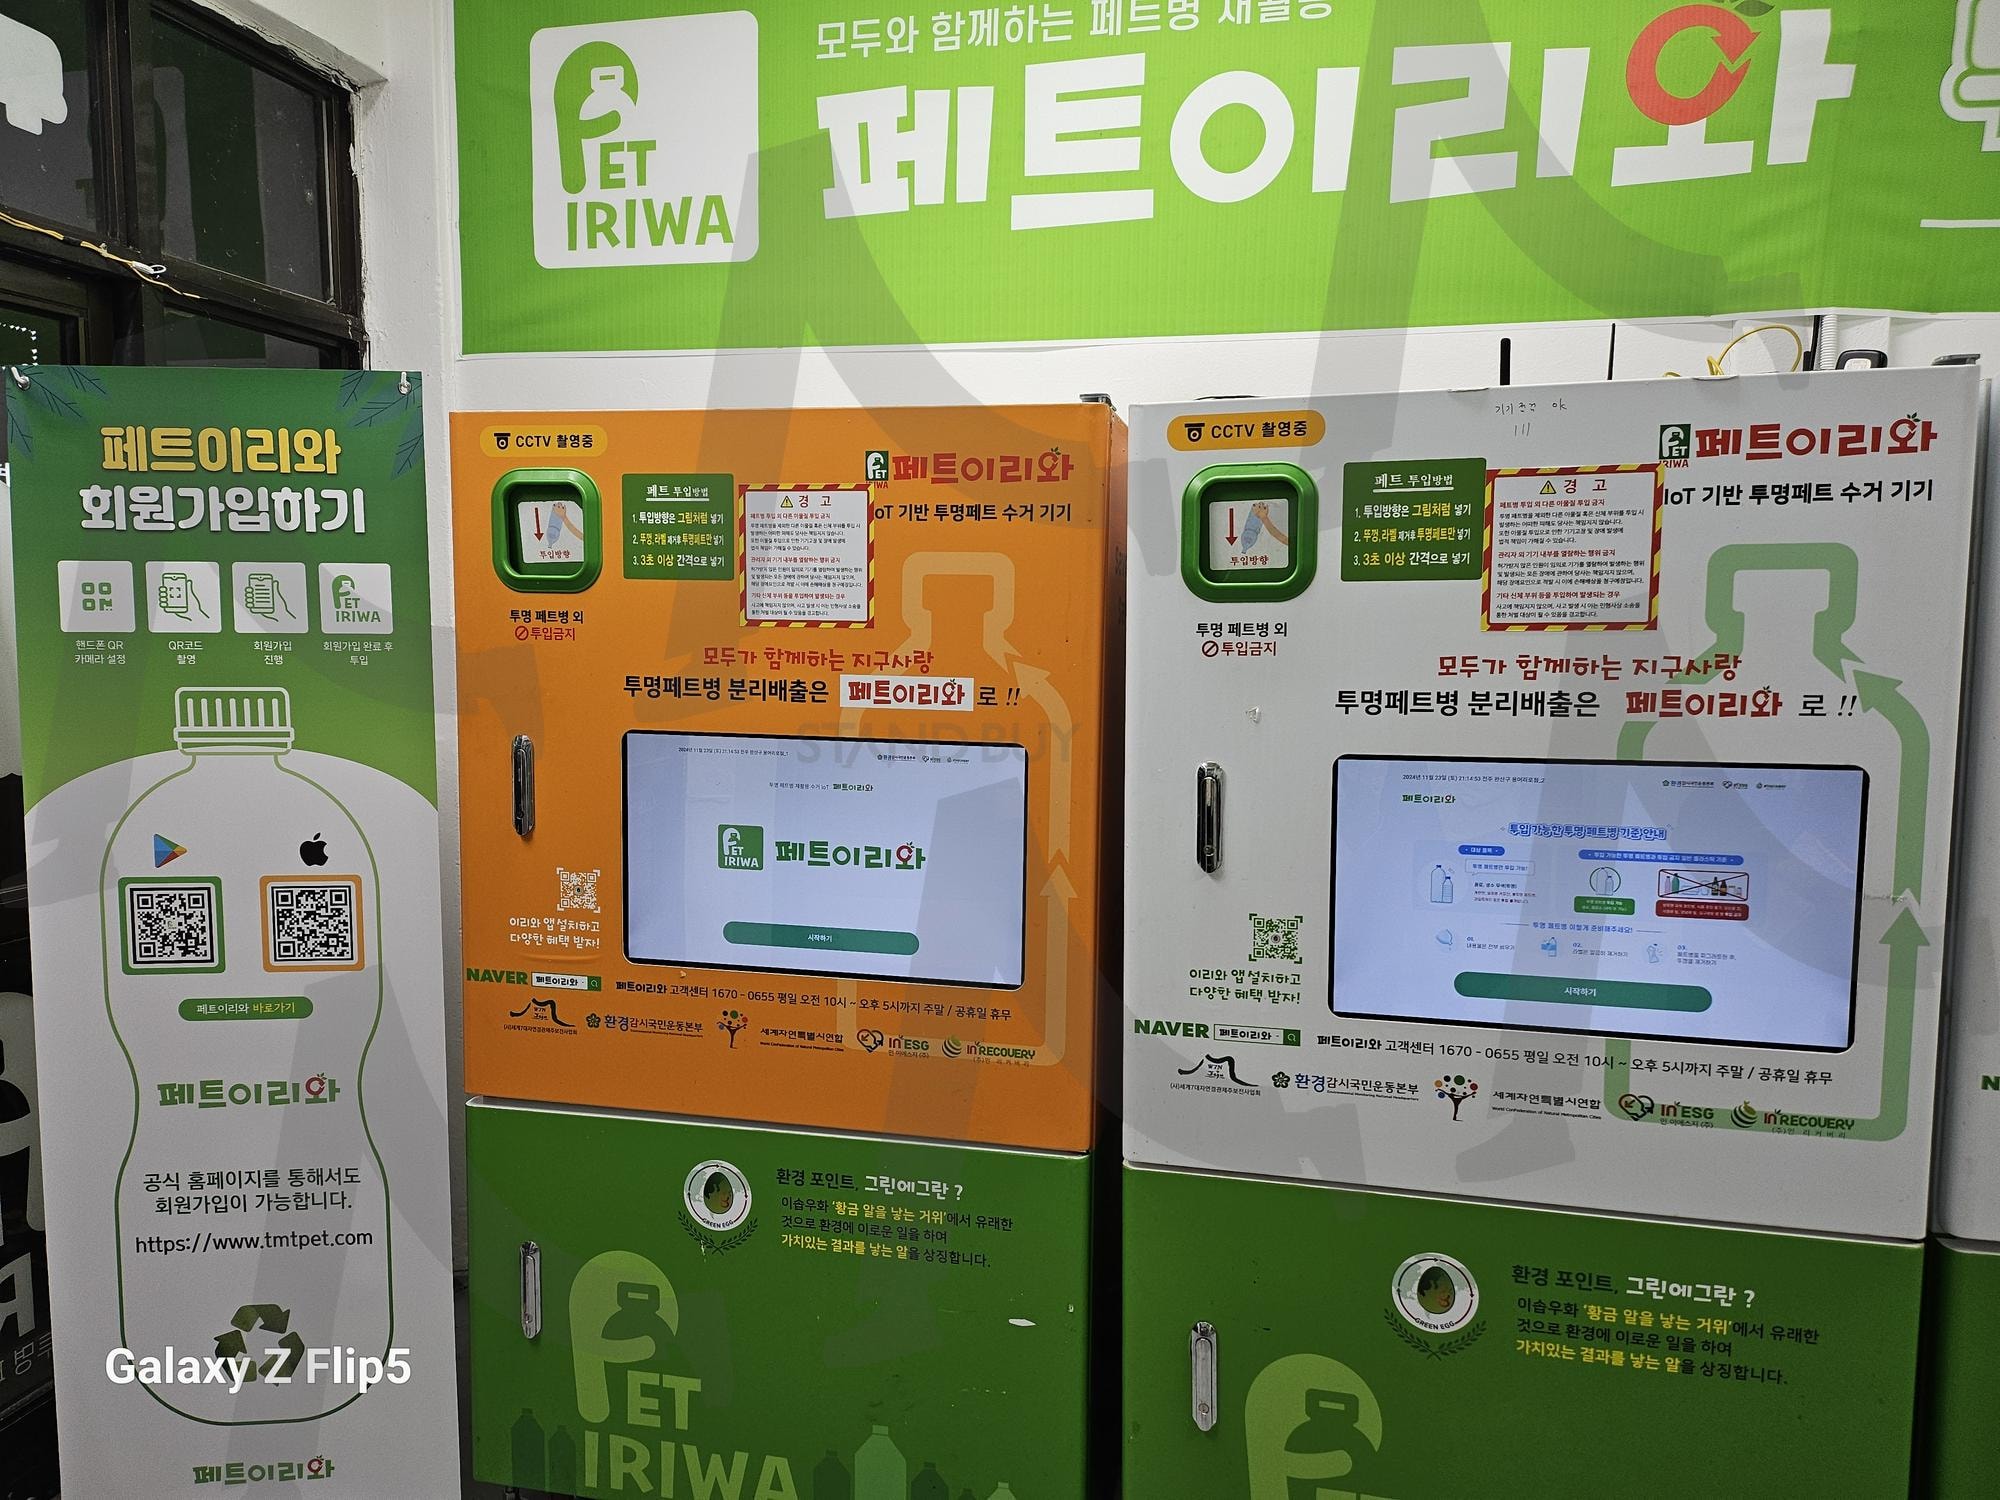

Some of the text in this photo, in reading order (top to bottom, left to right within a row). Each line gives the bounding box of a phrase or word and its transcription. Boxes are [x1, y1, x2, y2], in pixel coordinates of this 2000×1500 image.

[816, 15, 919, 61] 모두와
[932, 4, 1074, 52] 함께하는
[816, 2, 1856, 230] 페트이리와
[566, 192, 735, 252] IRIWA
[1211, 421, 1307, 439] CCTV 촬영중
[1696, 418, 1938, 460] 페트이리와
[100, 426, 341, 474] 페트이리와
[515, 433, 593, 449] CCTV 촬영중
[893, 451, 1074, 484] 페트이리와
[1374, 473, 1454, 489] 페트 투입방법
[1664, 480, 1933, 506] IoT 기반 투명페트 수거 기기
[79, 485, 366, 533] 회원가입하기
[898, 503, 1071, 522] 기반 투명페트 수거 기기
[1355, 503, 1471, 518] 1. 투입방향은 그림처럼 넣기
[1354, 531, 1361, 542] 2.
[1230, 555, 1268, 566] 투입방향
[1353, 552, 1470, 566] 3. 3초 이상 간격으로 넣기
[335, 610, 381, 623] IRIWA
[1196, 622, 1288, 638] 투명 페트병 외
[75, 639, 123, 650] 핸드폰 QR
[168, 640, 203, 651] QR코드
[254, 640, 292, 651] 회원가입
[323, 641, 394, 652] 회원가입 완료 후
[1221, 641, 1277, 656] 투입금지
[75, 654, 126, 665] 카메라 설정
[176, 654, 196, 665] 촬영
[263, 654, 284, 665] 진행
[349, 654, 369, 666] 투입
[703, 647, 934, 674] 모두가 함께하는 지구사랑
[1437, 652, 1742, 681] 모두가 함께하는 지구사랑
[623, 676, 720, 701] 투명페트병
[728, 676, 829, 703] 분리배출은
[849, 678, 965, 706] 페트이리와
[977, 686, 998, 706] 로
[1334, 688, 1459, 716] 투명페트병
[1467, 688, 1600, 719] 분리배출은
[1626, 689, 1782, 718] 페트이리와
[1799, 691, 1827, 717] 로
[1402, 794, 1456, 804] 페트이리와
[1509, 823, 1666, 840] 투입 가능한 투명 페트병 기준 안내
[724, 855, 760, 869] IRIWA
[775, 841, 926, 870] 페트이리와
[509, 917, 600, 932] 이리와 앱 설치하고
[509, 933, 600, 949] 다양한 혜택 받자!
[466, 967, 578, 987] NAVER 페트이리와
[1564, 986, 1597, 997] 시작하기
[196, 1002, 295, 1015] 페트이리와 바로가기
[1134, 1019, 1272, 1041] NAVER 페트이리와
[1317, 1035, 1833, 1085] 페트이리와 고객센터 1670 0655 평일 오전 10시 오후 5시까지 주말 공휴일 휴무
[157, 1075, 340, 1109] 페트이리와
[142, 1166, 361, 1191] 공식 홈페이지를 통해서도
[154, 1191, 352, 1215] 회원가입이 가능합니다.
[135, 1230, 373, 1255] https://www.tmtpet.com
[1511, 1264, 1754, 1309] 환경 포인트, 그린에그란 ?
[1623, 1306, 1653, 1328] 알을
[1659, 1310, 1691, 1331] 낳는
[1769, 1323, 1820, 1345] 유래한
[192, 1457, 335, 1485] 페트이리와
